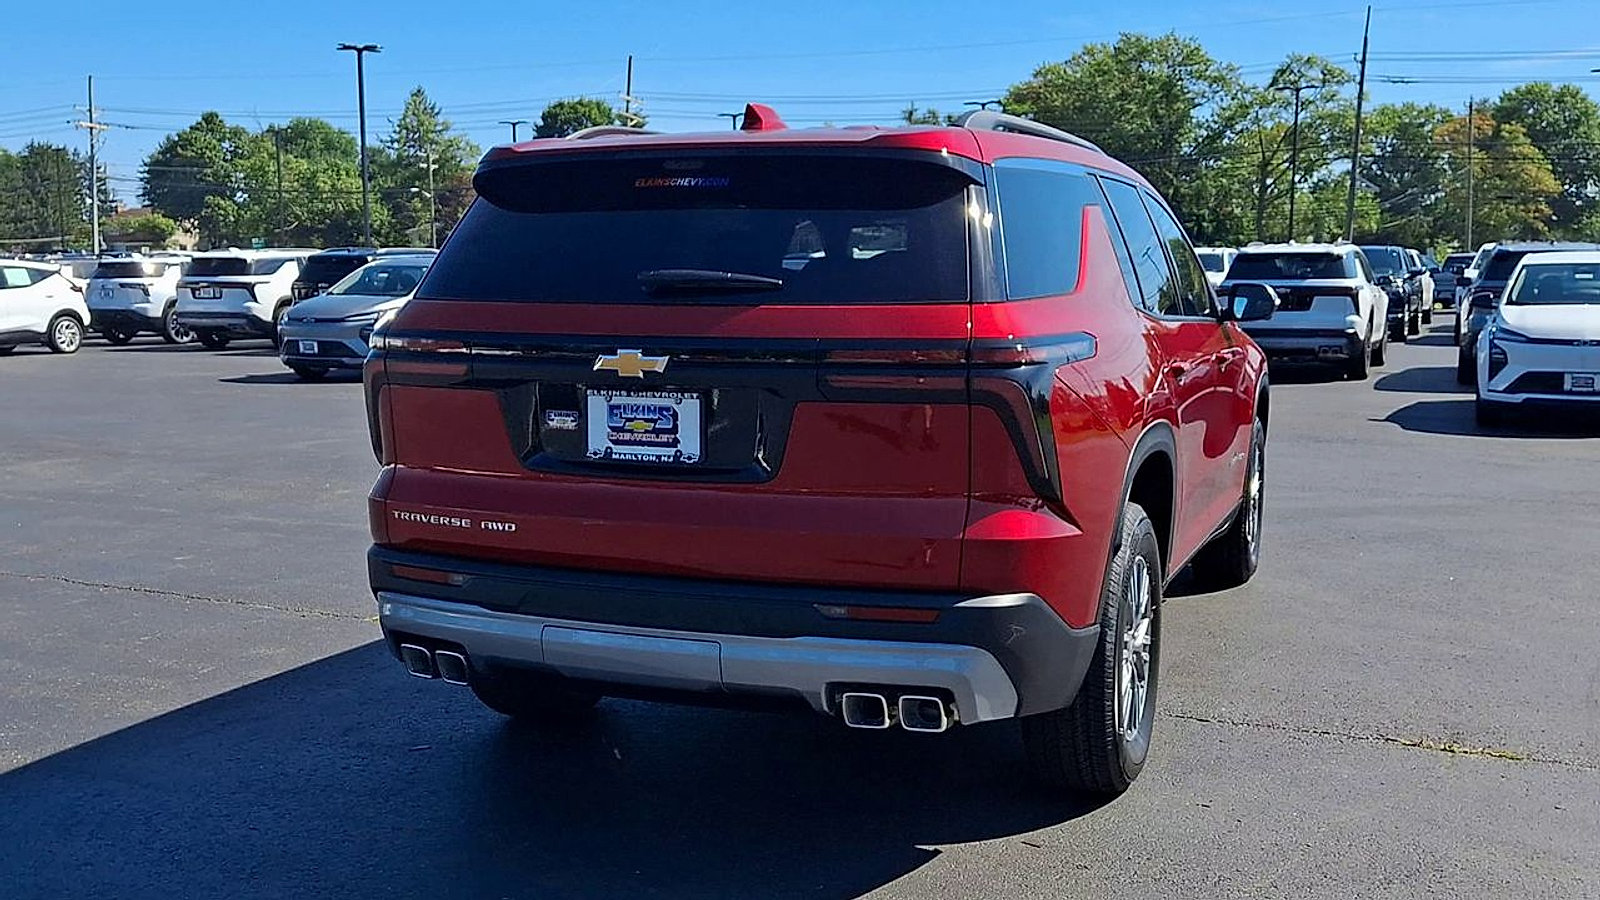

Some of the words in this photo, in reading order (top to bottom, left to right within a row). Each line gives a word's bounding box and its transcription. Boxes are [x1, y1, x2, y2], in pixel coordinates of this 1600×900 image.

[634, 177, 729, 187] ELKINSCHEVY.COM
[586, 389, 628, 397] ELKINS
[630, 390, 699, 399] CHEVROLET
[608, 403, 674, 429] ELKINS
[612, 453, 659, 462] MARLTON,
[392, 510, 472, 527] TRAVERSE
[481, 521, 516, 531] AWD
